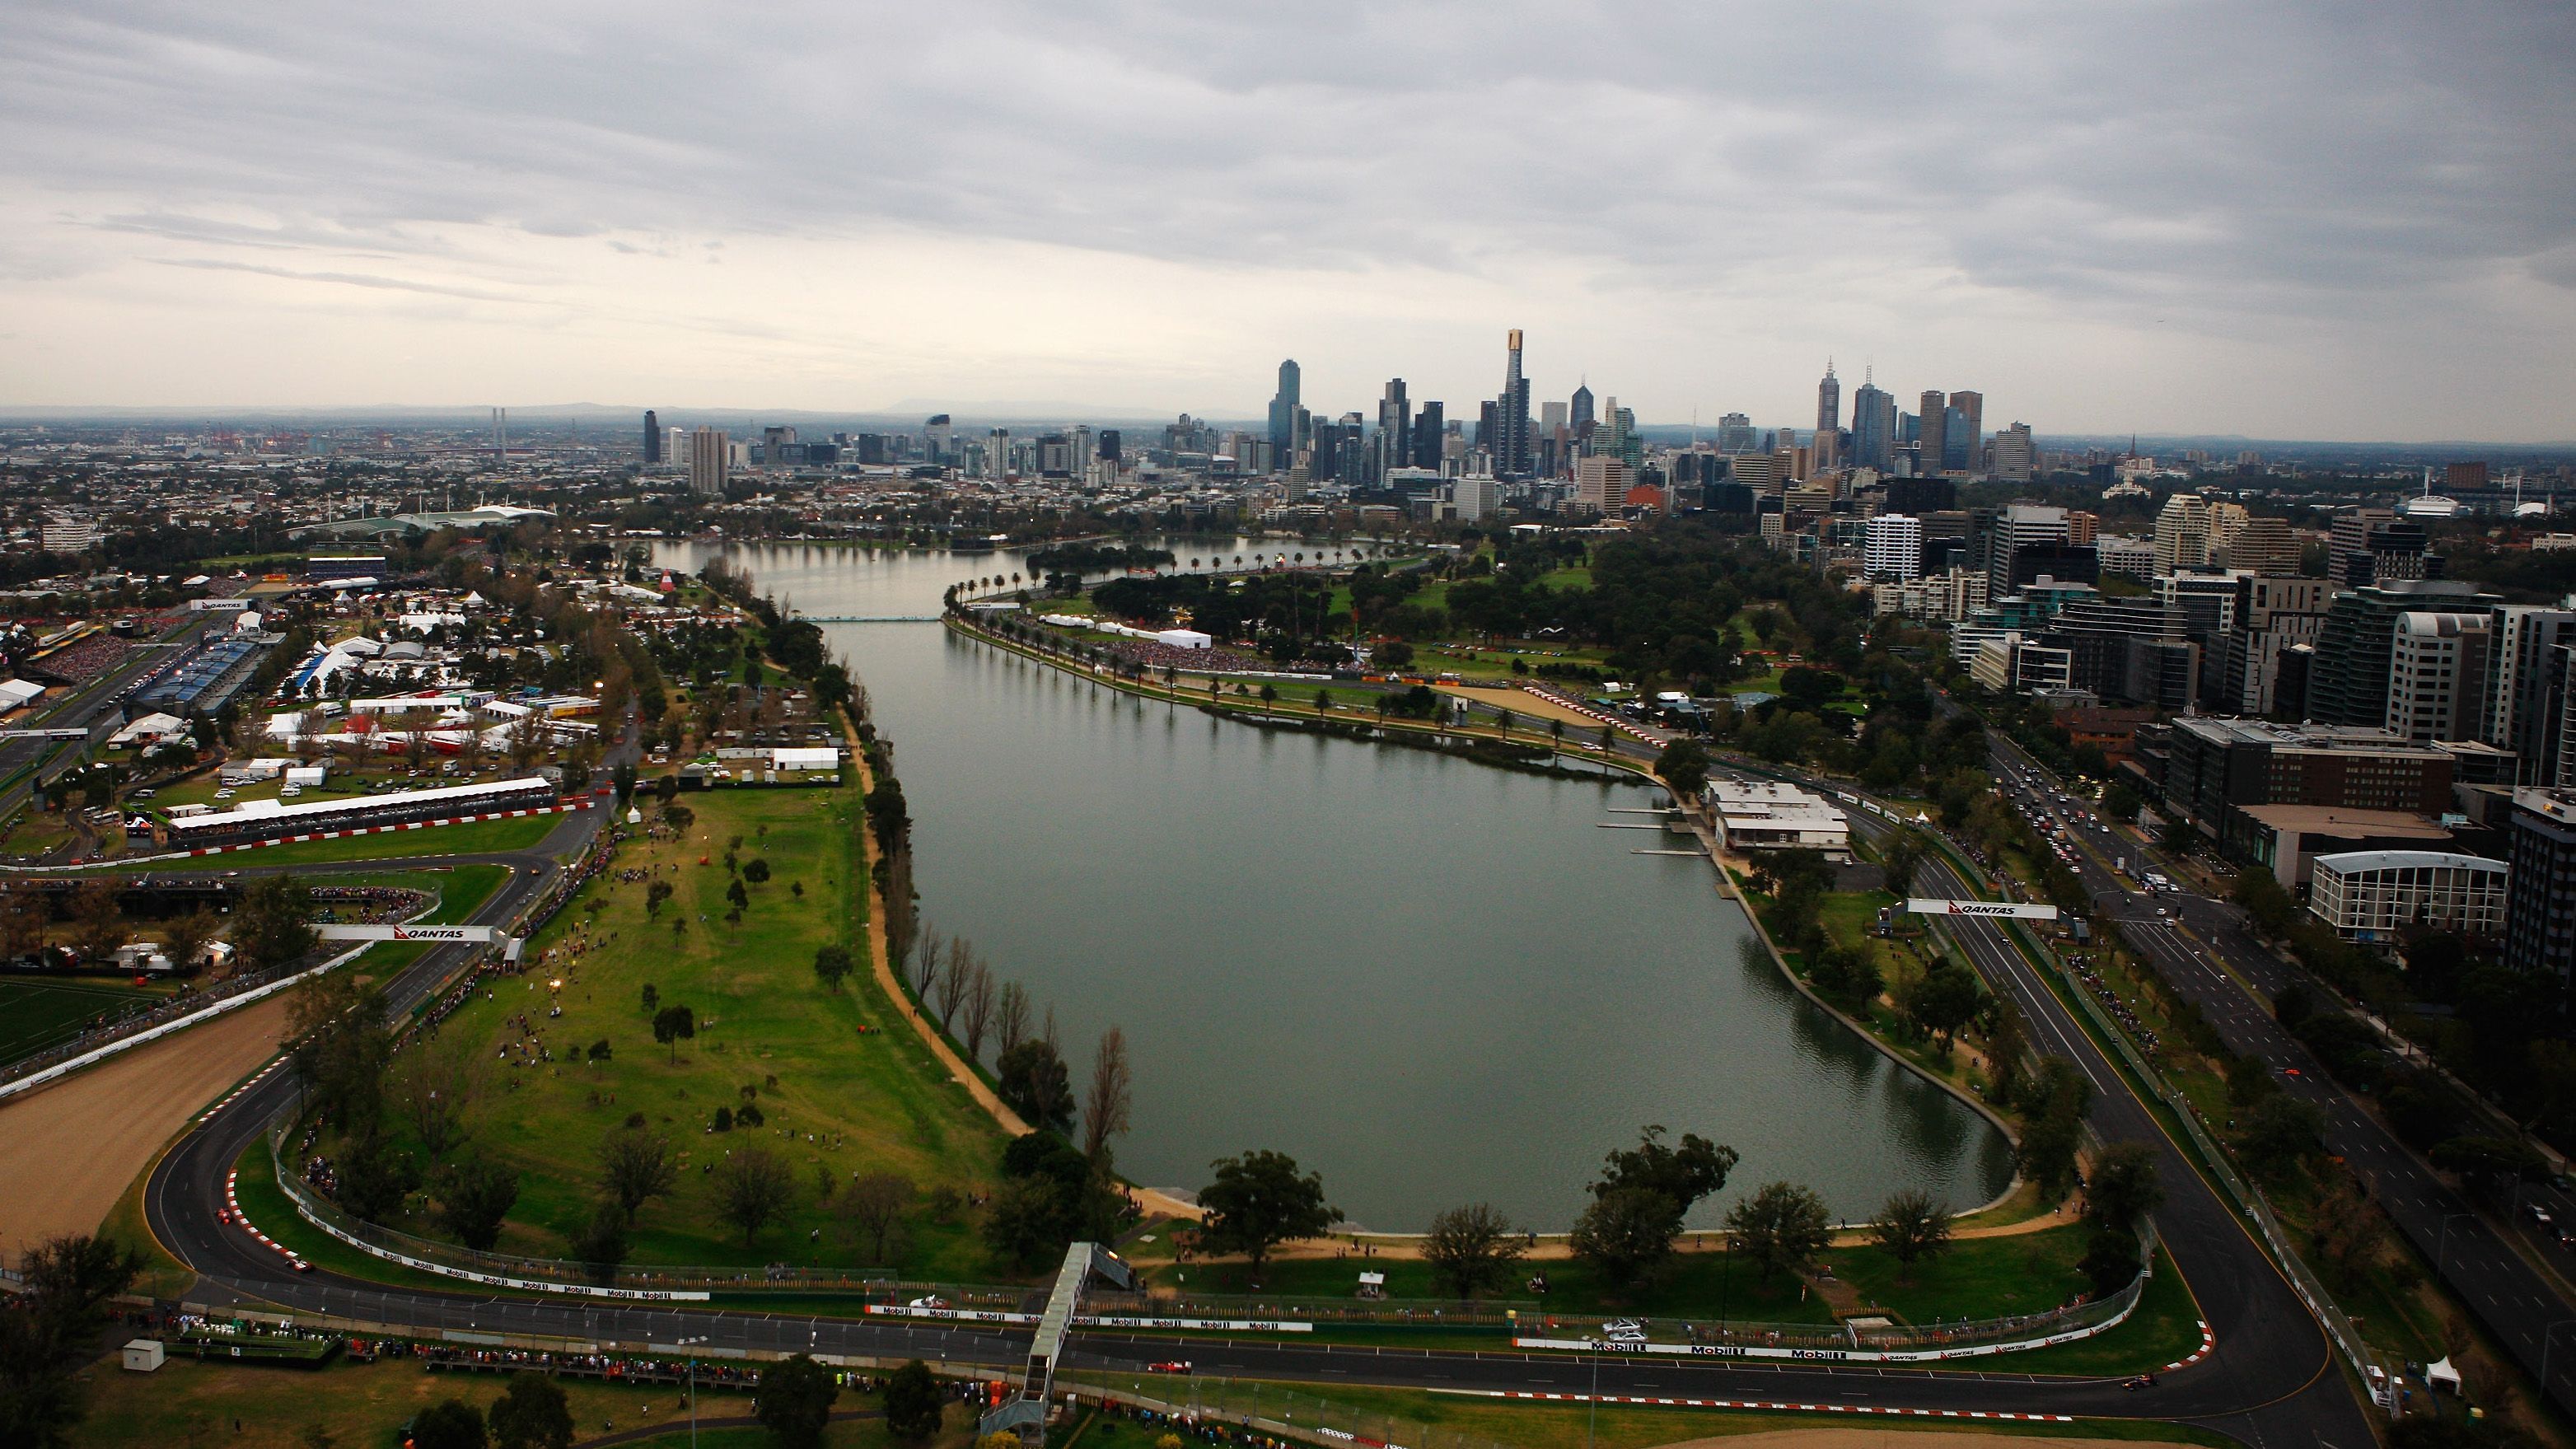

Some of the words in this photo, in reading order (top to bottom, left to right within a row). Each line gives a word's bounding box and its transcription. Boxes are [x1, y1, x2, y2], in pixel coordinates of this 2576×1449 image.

[1961, 905, 2016, 914] QANTAS
[408, 930, 464, 938] QANTAS
[446, 1269, 463, 1277] Mobil
[483, 1276, 501, 1284] Mobil
[883, 1306, 905, 1315] Mobil
[976, 1312, 998, 1320] Mobil
[1200, 1320, 1222, 1329] Mobil
[2050, 1335, 2073, 1344] QANTAS
[1592, 1342, 1632, 1351] Mobil
[1691, 1346, 1732, 1355] Mobil
[1792, 1350, 1832, 1358] Mobil
